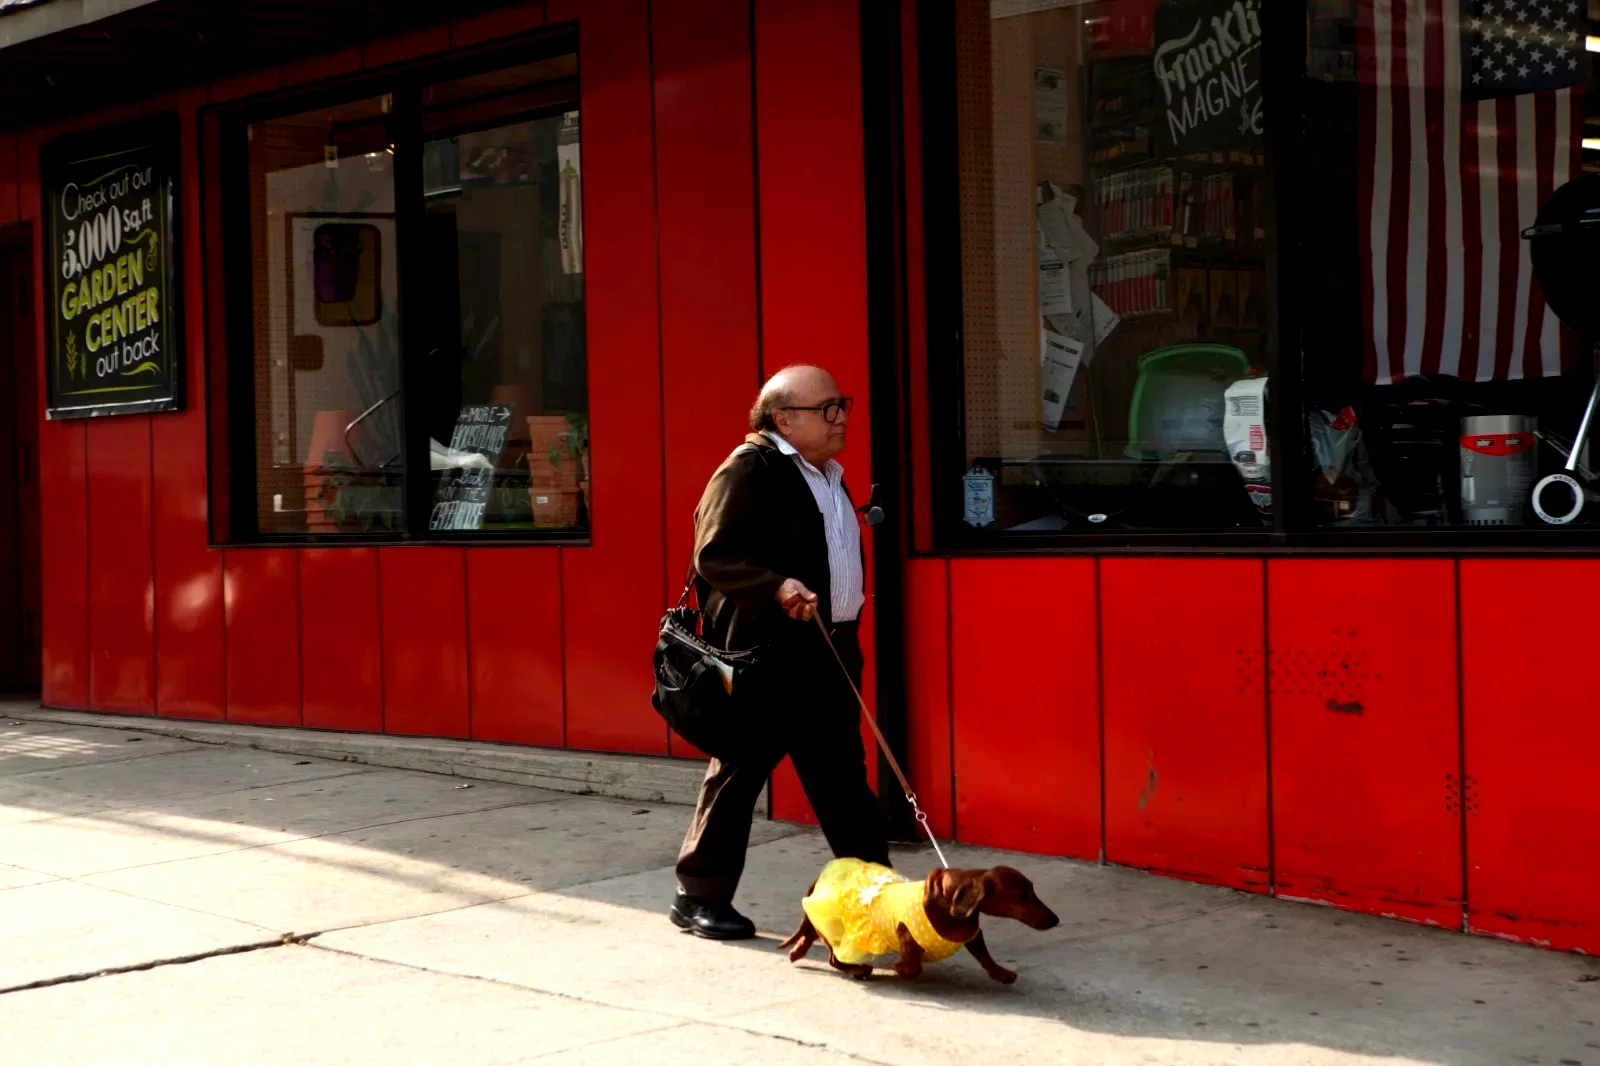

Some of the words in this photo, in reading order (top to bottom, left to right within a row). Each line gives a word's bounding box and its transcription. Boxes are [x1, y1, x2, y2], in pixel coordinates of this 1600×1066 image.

[1165, 40, 1262, 146] MAGNE
[61, 182, 107, 221] Check
[109, 172, 129, 200] out
[132, 166, 153, 190] our
[61, 247, 143, 320] GARDEN
[85, 286, 159, 352] CENTER
[96, 345, 120, 377] out
[122, 328, 160, 366] back
[468, 406, 498, 423] MORE
